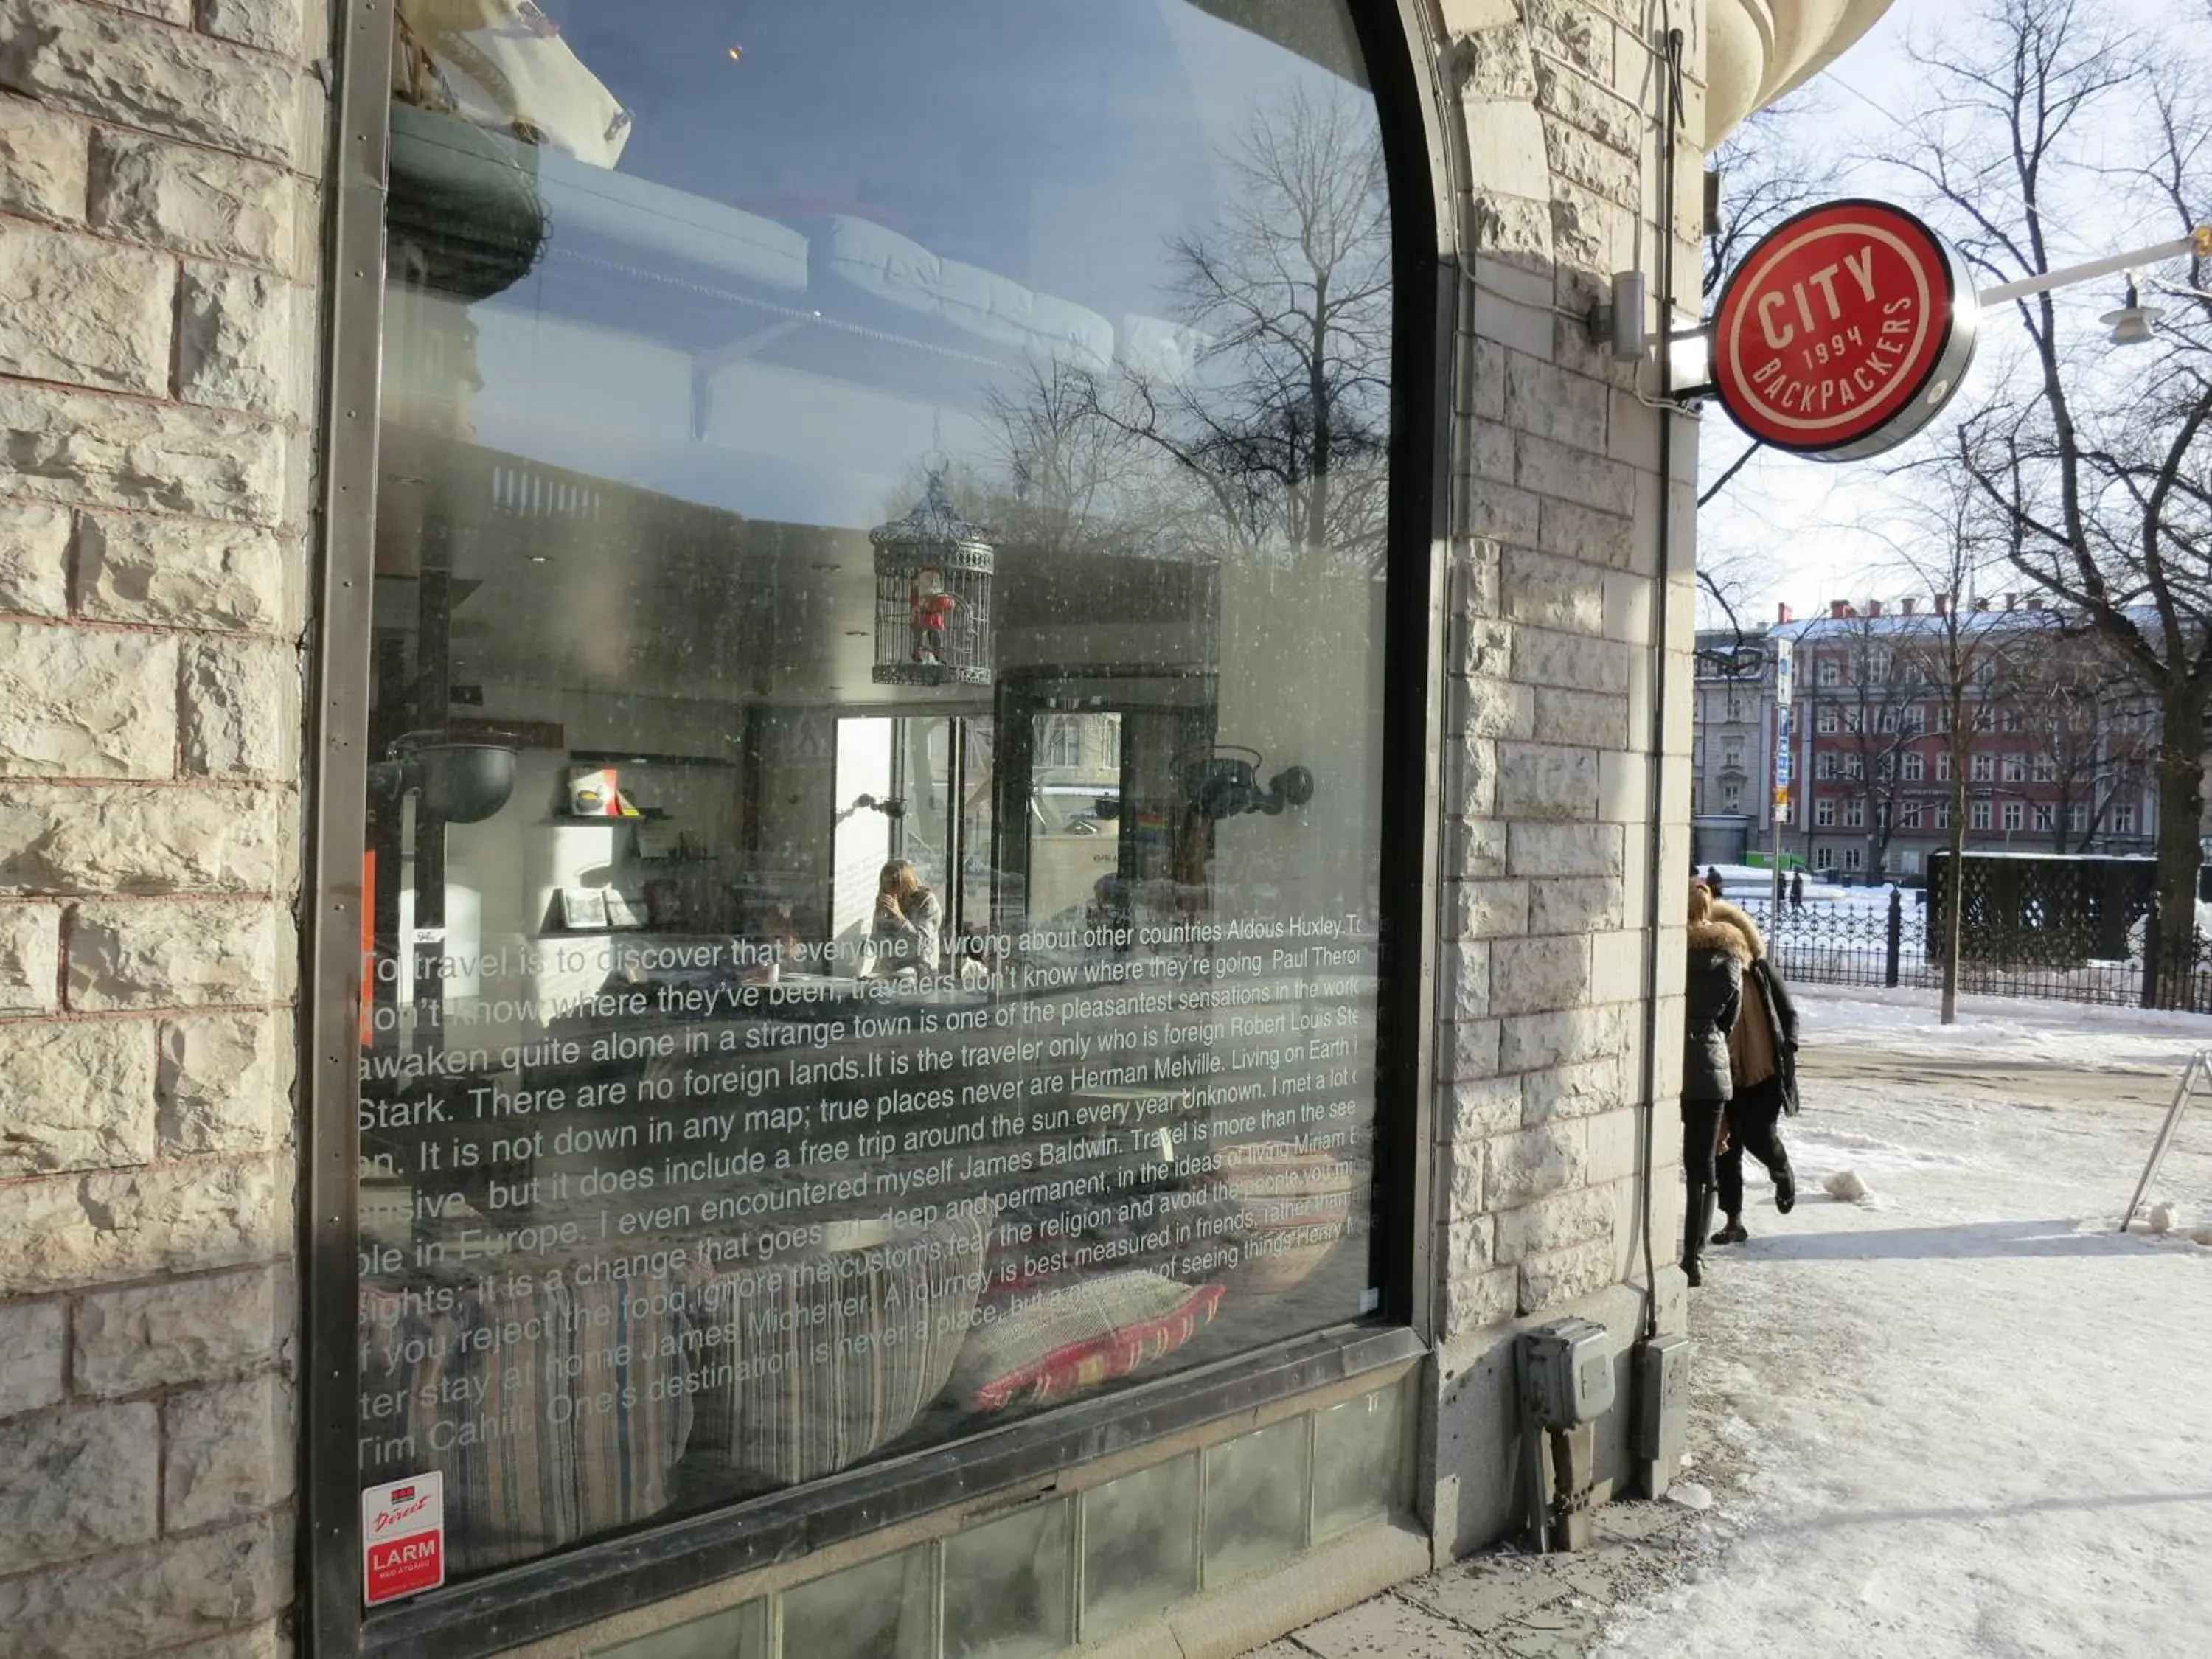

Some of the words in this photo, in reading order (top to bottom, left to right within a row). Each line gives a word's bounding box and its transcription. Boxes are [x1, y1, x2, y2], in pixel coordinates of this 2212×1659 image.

[1753, 296, 1911, 413] BACKPACKERS
[1757, 246, 1876, 349] CITY
[1803, 326, 1862, 369] 1994
[414, 945, 507, 981] travel
[518, 943, 544, 976] is
[556, 945, 585, 973] to
[597, 941, 722, 972] discover
[731, 937, 782, 966] that
[793, 937, 908, 967] everyone
[943, 933, 1011, 959] wrong
[1019, 926, 1077, 951] about
[1083, 923, 1135, 947] other
[1139, 919, 1222, 945] countries
[1227, 917, 1284, 941] Aldous
[551, 988, 647, 1019] where
[658, 979, 759, 1018] they've
[769, 982, 842, 1006] been,
[852, 973, 956, 1001] travelers
[961, 964, 1018, 992] don't
[1024, 964, 1077, 987] know
[1084, 959, 1144, 984] where
[1150, 954, 1211, 983] they're
[1215, 949, 1262, 978] going
[1273, 946, 1308, 970] Paul
[358, 1044, 488, 1081] awaken
[501, 1035, 580, 1076] quite
[591, 1032, 675, 1062] alone
[683, 1027, 708, 1054] in
[720, 1029, 736, 1051] a
[743, 1020, 845, 1049] strange
[853, 1015, 911, 1040] town
[920, 1009, 939, 1033] is
[945, 1009, 988, 1031] one
[995, 1001, 1019, 1027] of
[1023, 1001, 1054, 1025] the
[1062, 992, 1174, 1026] pleasantest
[1180, 985, 1270, 1010] sensations
[1276, 981, 1290, 1000] in
[1295, 978, 1318, 998] the
[358, 1092, 455, 1130] Stark.
[467, 1087, 566, 1119] There
[577, 1080, 627, 1107] are
[637, 1078, 674, 1102] no
[684, 1063, 780, 1098] foreign
[890, 1049, 909, 1075] is
[916, 1046, 954, 1074] the
[960, 1037, 1044, 1068] traveler
[1049, 1030, 1093, 1061] only
[1097, 1027, 1137, 1052] who
[1143, 1024, 1161, 1048] is
[1164, 1019, 1225, 1047] foreign
[1230, 1016, 1286, 1038] Robert
[1291, 1008, 1332, 1032] Louis
[420, 1141, 441, 1172] It
[452, 1136, 480, 1169] is
[492, 1130, 544, 1163] not
[554, 1124, 637, 1155] down
[649, 1116, 673, 1144] in
[684, 1113, 735, 1143] any
[744, 1105, 810, 1133] map;
[820, 1098, 870, 1123] true
[877, 1088, 954, 1121] places
[961, 1079, 1024, 1106] never
[1029, 1074, 1064, 1096] are
[1071, 1065, 1148, 1091] Herman
[1154, 1052, 1226, 1081] Melville.
[1232, 1048, 1281, 1071] Living
[1284, 1046, 1305, 1062] on
[1310, 1039, 1349, 1060] Earth
[489, 1175, 541, 1210] but
[553, 1171, 569, 1200] it
[580, 1167, 654, 1197] does
[665, 1147, 766, 1185] include
[774, 1148, 795, 1170] a
[799, 1139, 850, 1167] free
[858, 1130, 897, 1162] trip
[903, 1114, 986, 1152] around
[991, 1111, 1026, 1138] the
[1032, 1107, 1069, 1133] sun
[1076, 1101, 1130, 1126] every
[1136, 1093, 1175, 1121] year
[1181, 1082, 1267, 1110] Unknown.
[1272, 1076, 1277, 1096] I
[1282, 1071, 1312, 1095] met
[1315, 1072, 1326, 1091] a
[1330, 1068, 1349, 1088] lot
[416, 1238, 445, 1268] in
[460, 1224, 588, 1261] Europe.
[600, 1209, 608, 1239] I
[619, 1203, 690, 1236] even
[700, 1171, 869, 1222] encountered
[876, 1155, 953, 1196] myself
[960, 1150, 1034, 1180] James
[1040, 1137, 1124, 1167] Baldwin.
[1130, 1119, 1189, 1152] Travel
[1193, 1120, 1208, 1142] is
[1213, 1118, 1256, 1136] more
[1261, 1107, 1296, 1130] than
[1301, 1102, 1326, 1121] the
[479, 1273, 497, 1306] it
[507, 1268, 533, 1298] is
[546, 1267, 567, 1292] a
[575, 1248, 686, 1287] change
[695, 1231, 749, 1262] that
[758, 1224, 824, 1262] goes
[880, 1206, 939, 1231] deep
[946, 1189, 987, 1221] and
[994, 1167, 1110, 1220] permanent,
[1118, 1165, 1134, 1188] in
[1139, 1161, 1169, 1184] the
[1175, 1151, 1222, 1177] ideas
[1295, 1130, 1346, 1155] Miriam
[358, 1388, 409, 1421] ter
[419, 1372, 492, 1408] stay
[549, 1345, 632, 1383] home
[642, 1321, 737, 1361] James
[883, 1283, 901, 1310] A
[908, 1269, 993, 1316] journey
[1000, 1261, 1018, 1284] is
[1023, 1249, 1069, 1278] best
[1075, 1225, 1169, 1267] measured
[1175, 1221, 1191, 1245] in
[1196, 1210, 1257, 1239] friends,
[383, 1335, 448, 1377] you
[459, 1315, 552, 1355] reject
[563, 1300, 611, 1333] the
[1001, 1221, 1033, 1247] the
[1039, 1207, 1112, 1239] religion
[1118, 1194, 1153, 1222] and
[1158, 1184, 1208, 1211] avoid
[1213, 1178, 1239, 1203] the
[546, 1384, 638, 1429] One's
[647, 1349, 801, 1402] destination
[1158, 1253, 1178, 1280] of
[1181, 1245, 1238, 1276] seeing
[1243, 1233, 1293, 1261] things
[373, 1539, 435, 1571] LARM
